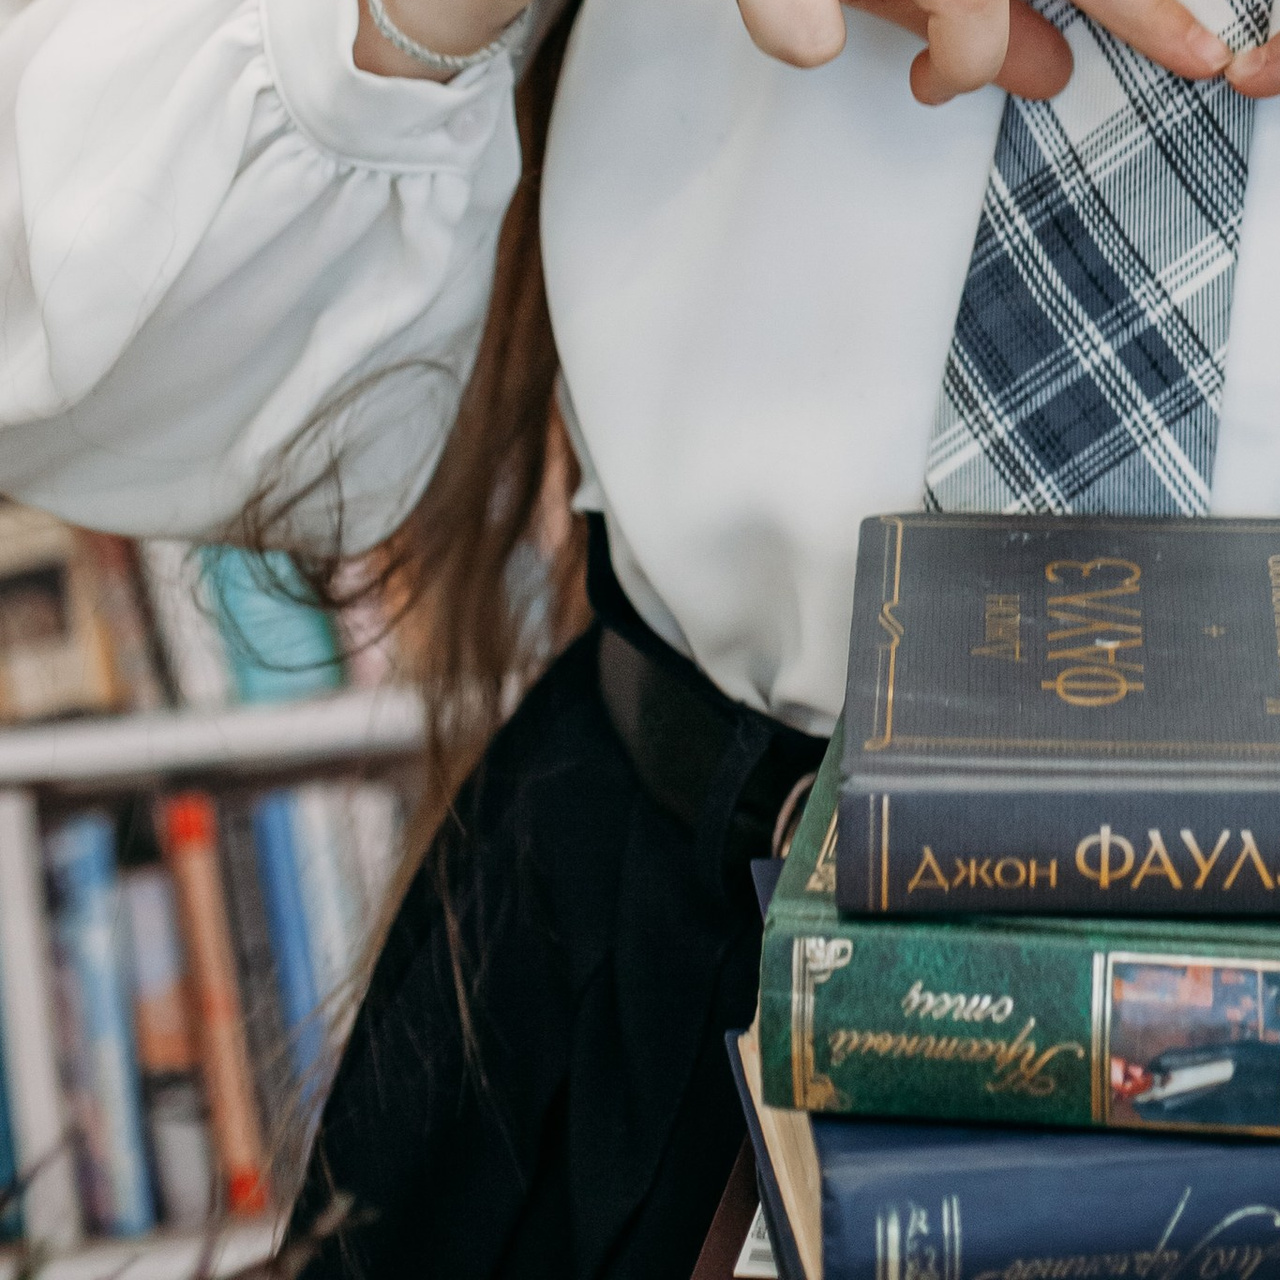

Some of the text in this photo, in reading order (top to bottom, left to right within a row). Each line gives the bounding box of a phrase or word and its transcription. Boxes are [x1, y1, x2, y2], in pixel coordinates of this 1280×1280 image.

[970, 594, 1027, 663] Джон
[1041, 557, 1144, 707] ФАУЛЗ
[907, 845, 1057, 894] Джон
[902, 980, 1014, 1024] отец
[828, 1016, 1086, 1096] Крестный
